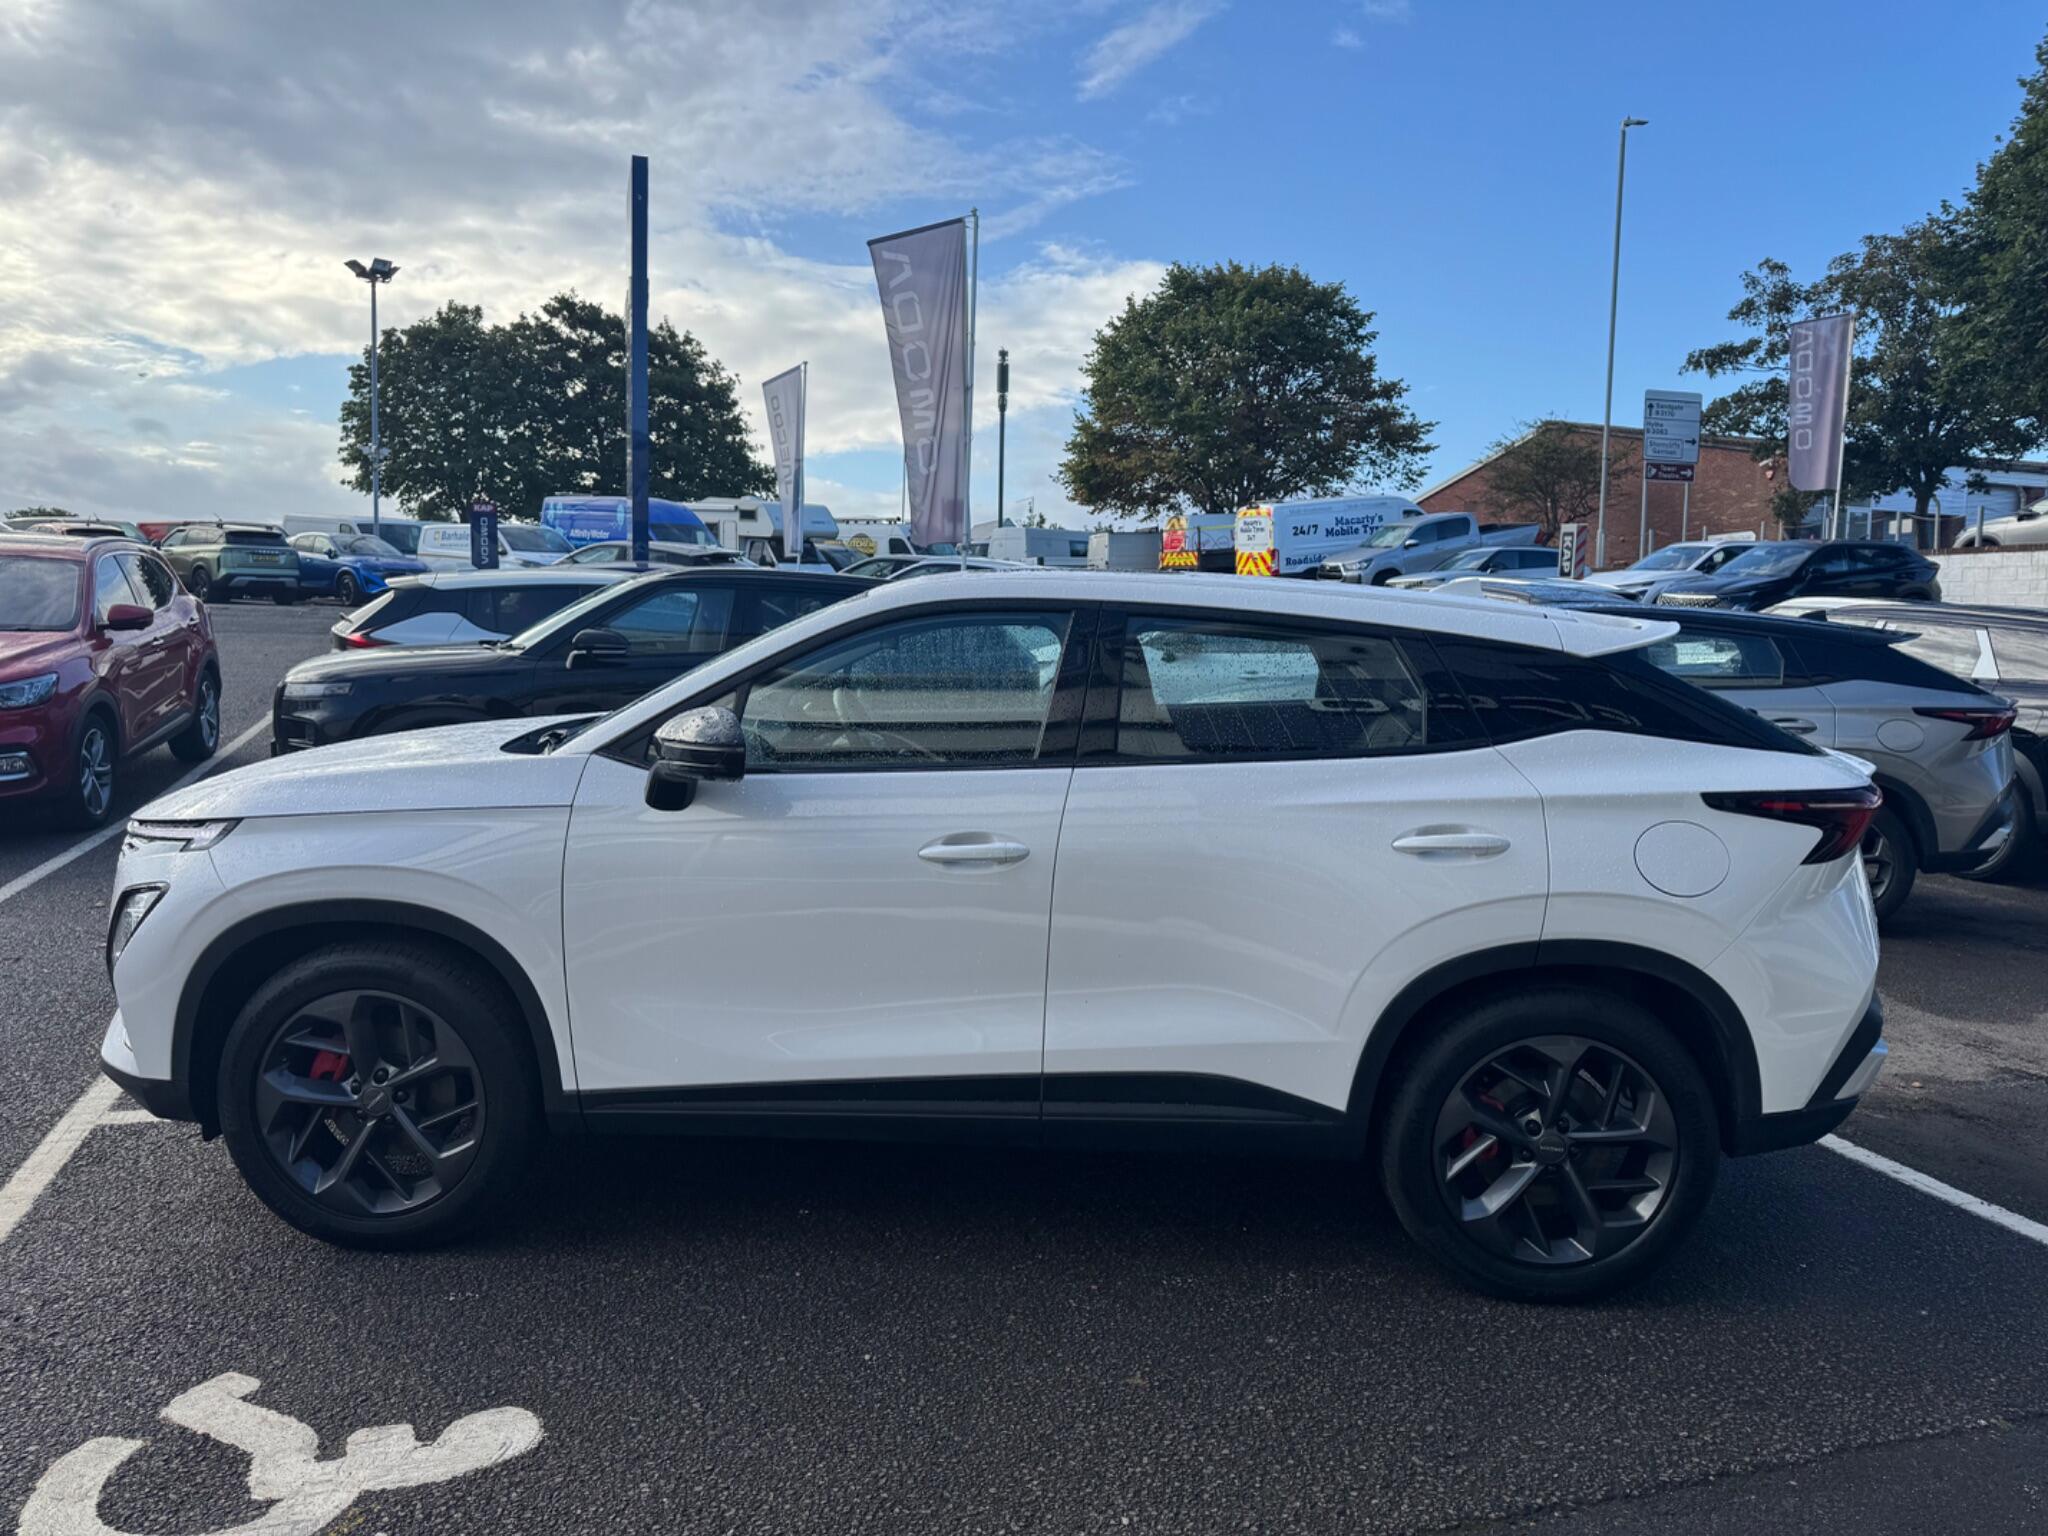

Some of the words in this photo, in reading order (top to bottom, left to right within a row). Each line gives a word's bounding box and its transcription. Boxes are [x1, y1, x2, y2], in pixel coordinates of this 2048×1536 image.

[473, 504, 494, 512] KAP
[1335, 513, 1384, 526] Macarty's
[1292, 524, 1319, 536] 24/7
[1325, 526, 1360, 537] Mobile
[1362, 524, 1379, 536] Tyr
[1563, 535, 1573, 573] KAP
